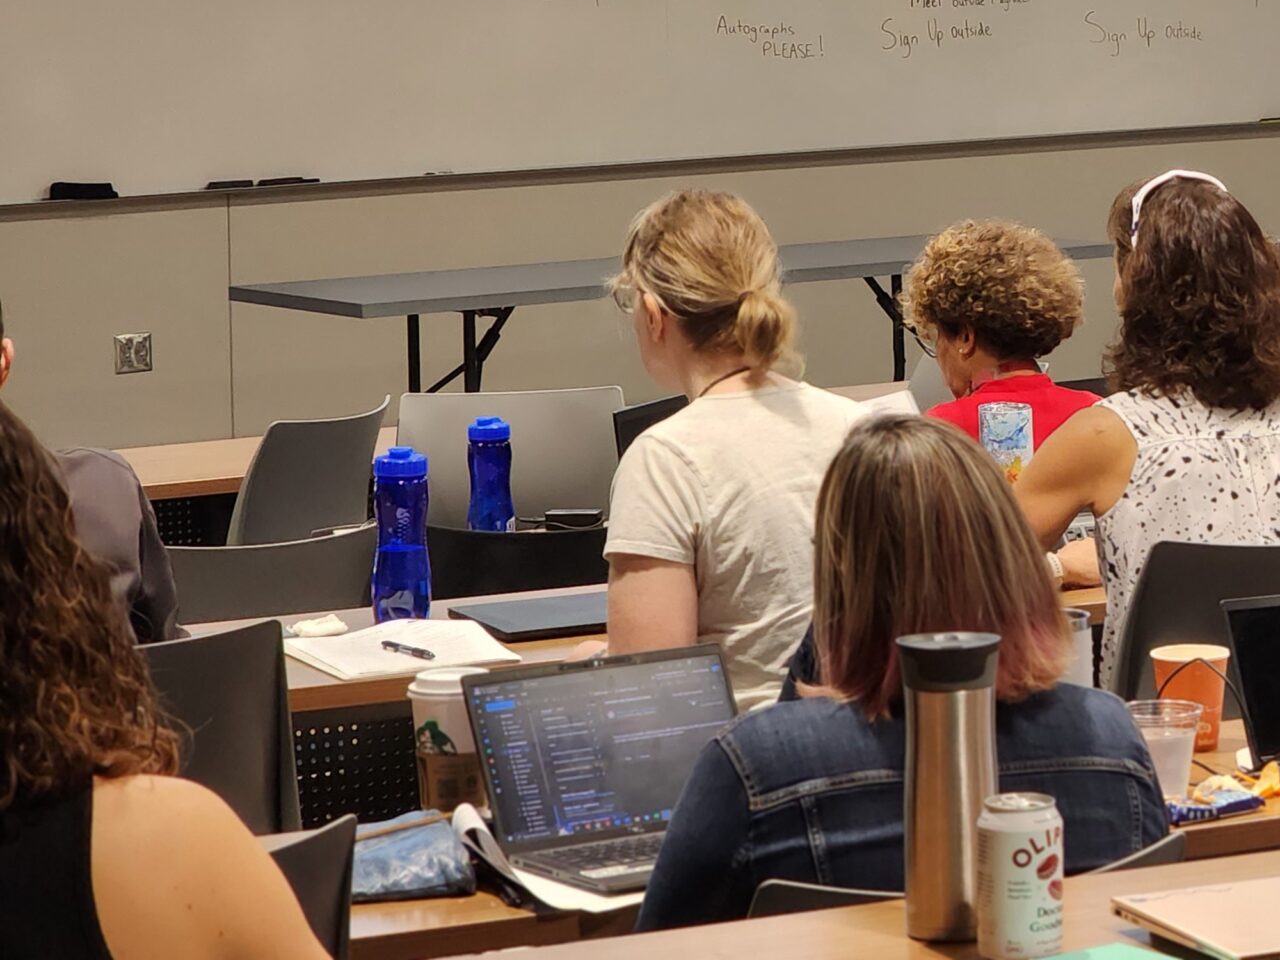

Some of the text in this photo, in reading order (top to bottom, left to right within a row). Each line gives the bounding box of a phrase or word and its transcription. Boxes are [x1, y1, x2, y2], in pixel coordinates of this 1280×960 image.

[716, 15, 796, 43] Autographs
[881, 18, 919, 59] Sign
[928, 18, 944, 47] Up
[1085, 10, 1128, 57] Sign
[1136, 16, 1156, 48] Up
